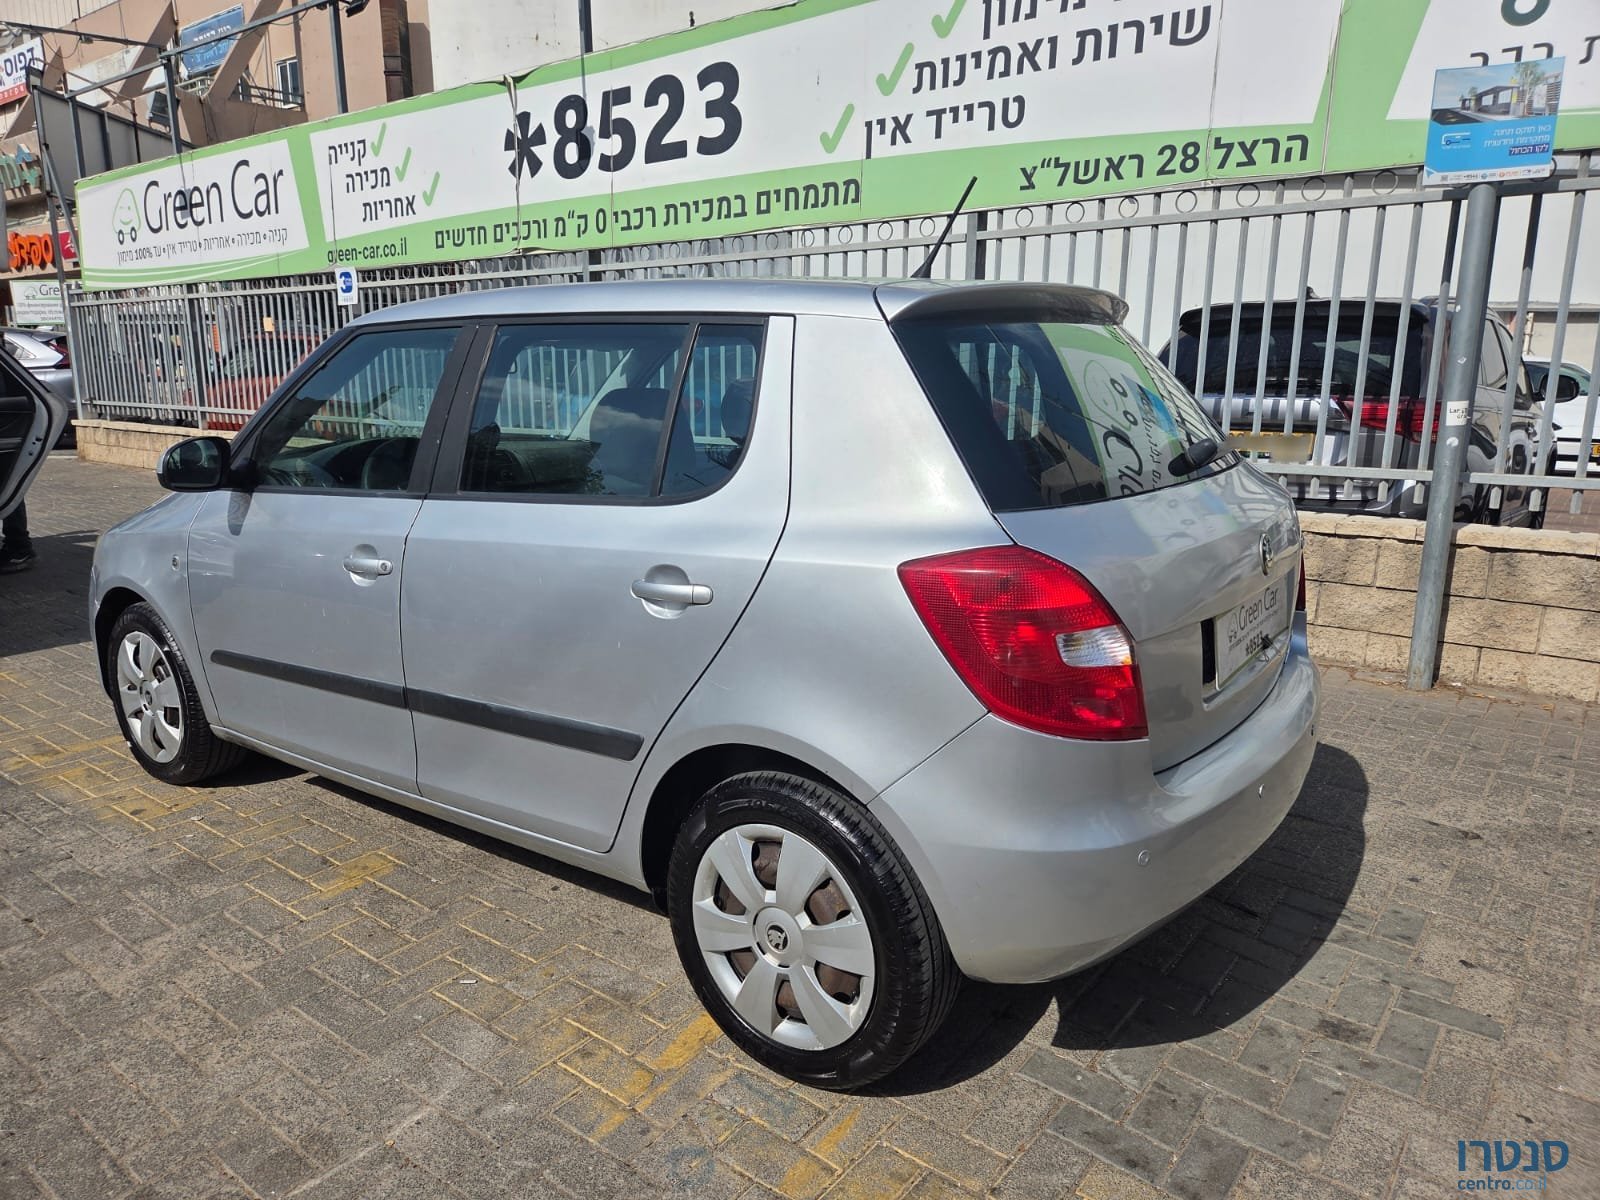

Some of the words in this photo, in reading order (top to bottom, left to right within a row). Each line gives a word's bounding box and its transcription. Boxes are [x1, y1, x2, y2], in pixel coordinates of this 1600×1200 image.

[982, 0, 1087, 41] מון
[1072, 4, 1212, 66] שירות
[912, 35, 1058, 95] ואמינות
[926, 95, 1026, 140] טרייד
[865, 113, 914, 160] אין
[328, 138, 366, 166] קנייה
[1156, 141, 1200, 177] 28
[1214, 134, 1309, 170] הרצל
[346, 166, 391, 193] מכירה
[144, 180, 224, 234] Green
[231, 159, 284, 219] Car
[362, 195, 416, 222] אחריות
[756, 178, 861, 214] מתמחים
[595, 208, 606, 234] 0
[613, 206, 657, 231] רכבי
[663, 196, 747, 226] במכירת
[203, 235, 230, 251] אחריות
[237, 231, 261, 247] מכירה
[268, 228, 288, 245] קניה
[435, 223, 487, 249] חדשים
[493, 218, 548, 242] ורכבים
[39, 284, 60, 296] Gre
[1239, 600, 1262, 630] Green
[1264, 587, 1279, 610] Car
